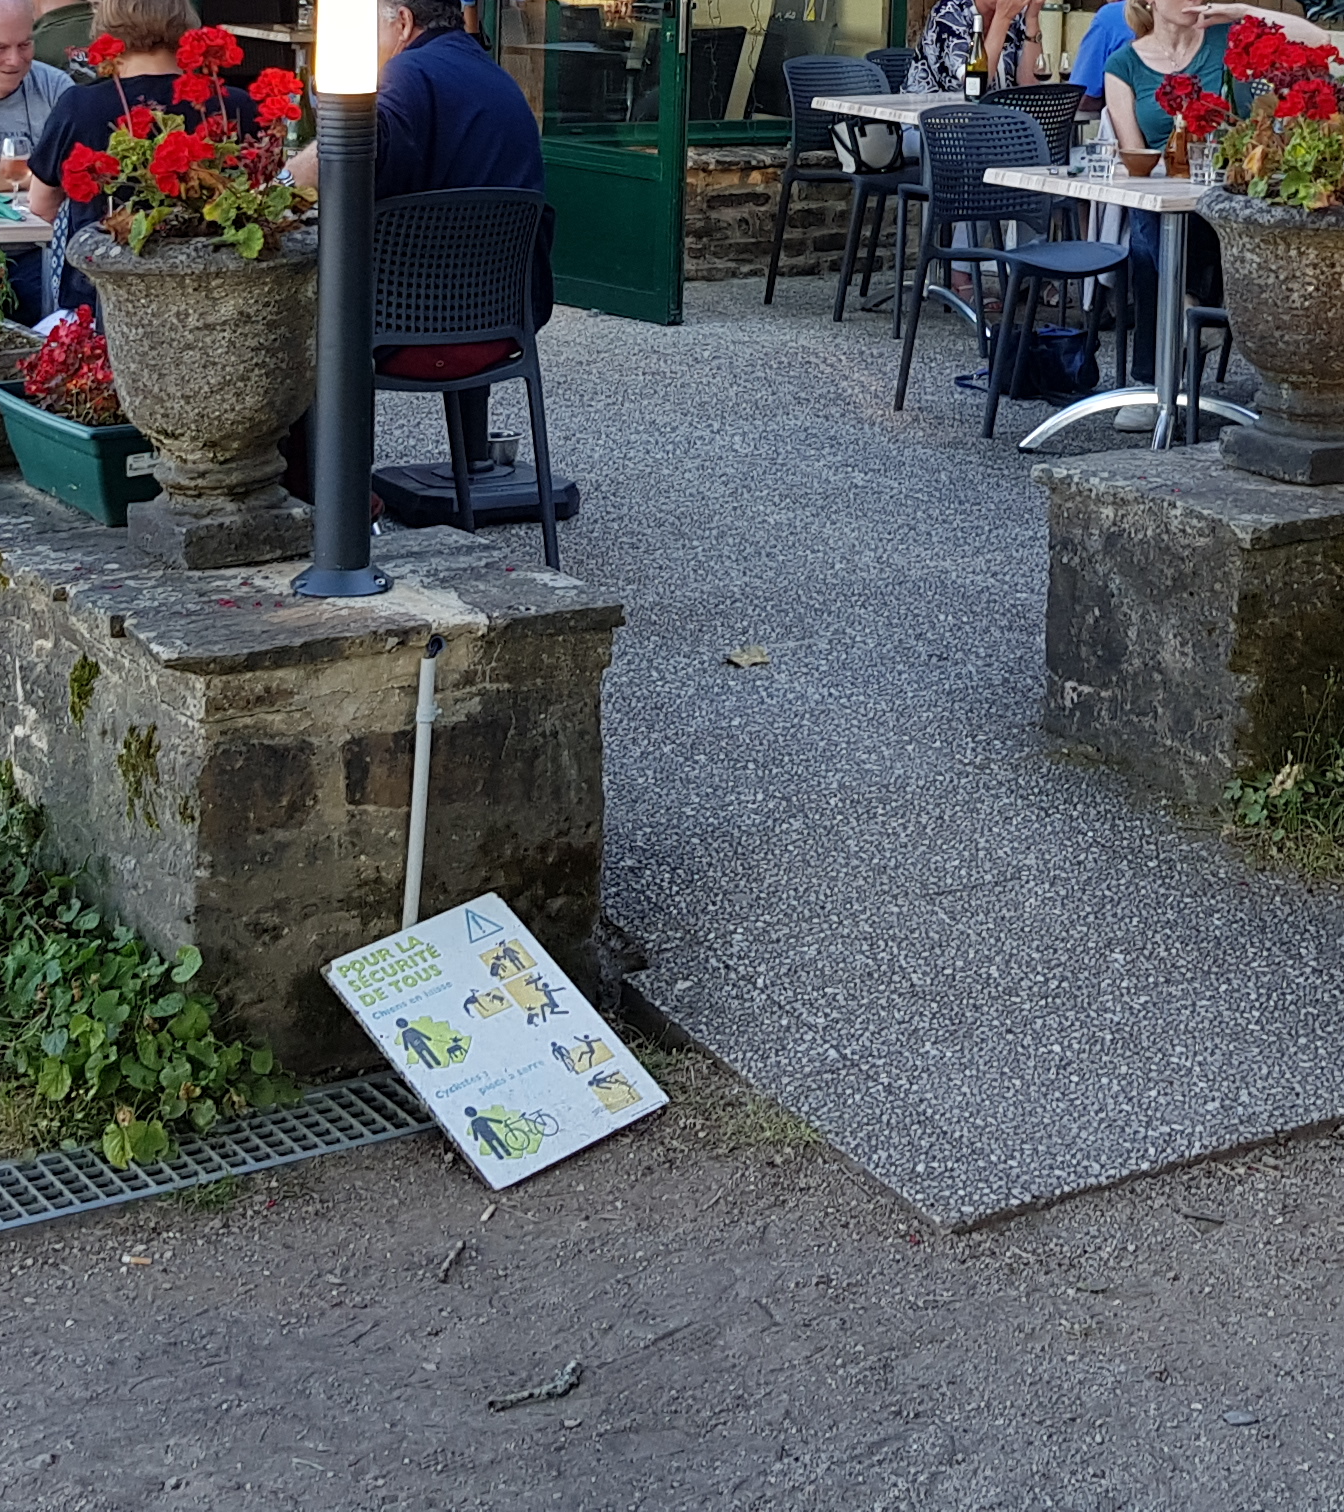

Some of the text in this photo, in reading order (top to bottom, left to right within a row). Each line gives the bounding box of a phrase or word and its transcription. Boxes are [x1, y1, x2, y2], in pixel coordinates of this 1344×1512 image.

[337, 936, 424, 978] POUR LA
[348, 942, 442, 992] SÉCURITÉ
[358, 964, 442, 1007] DE TOUS
[372, 1001, 407, 1020] Chiens
[409, 995, 423, 1004] en
